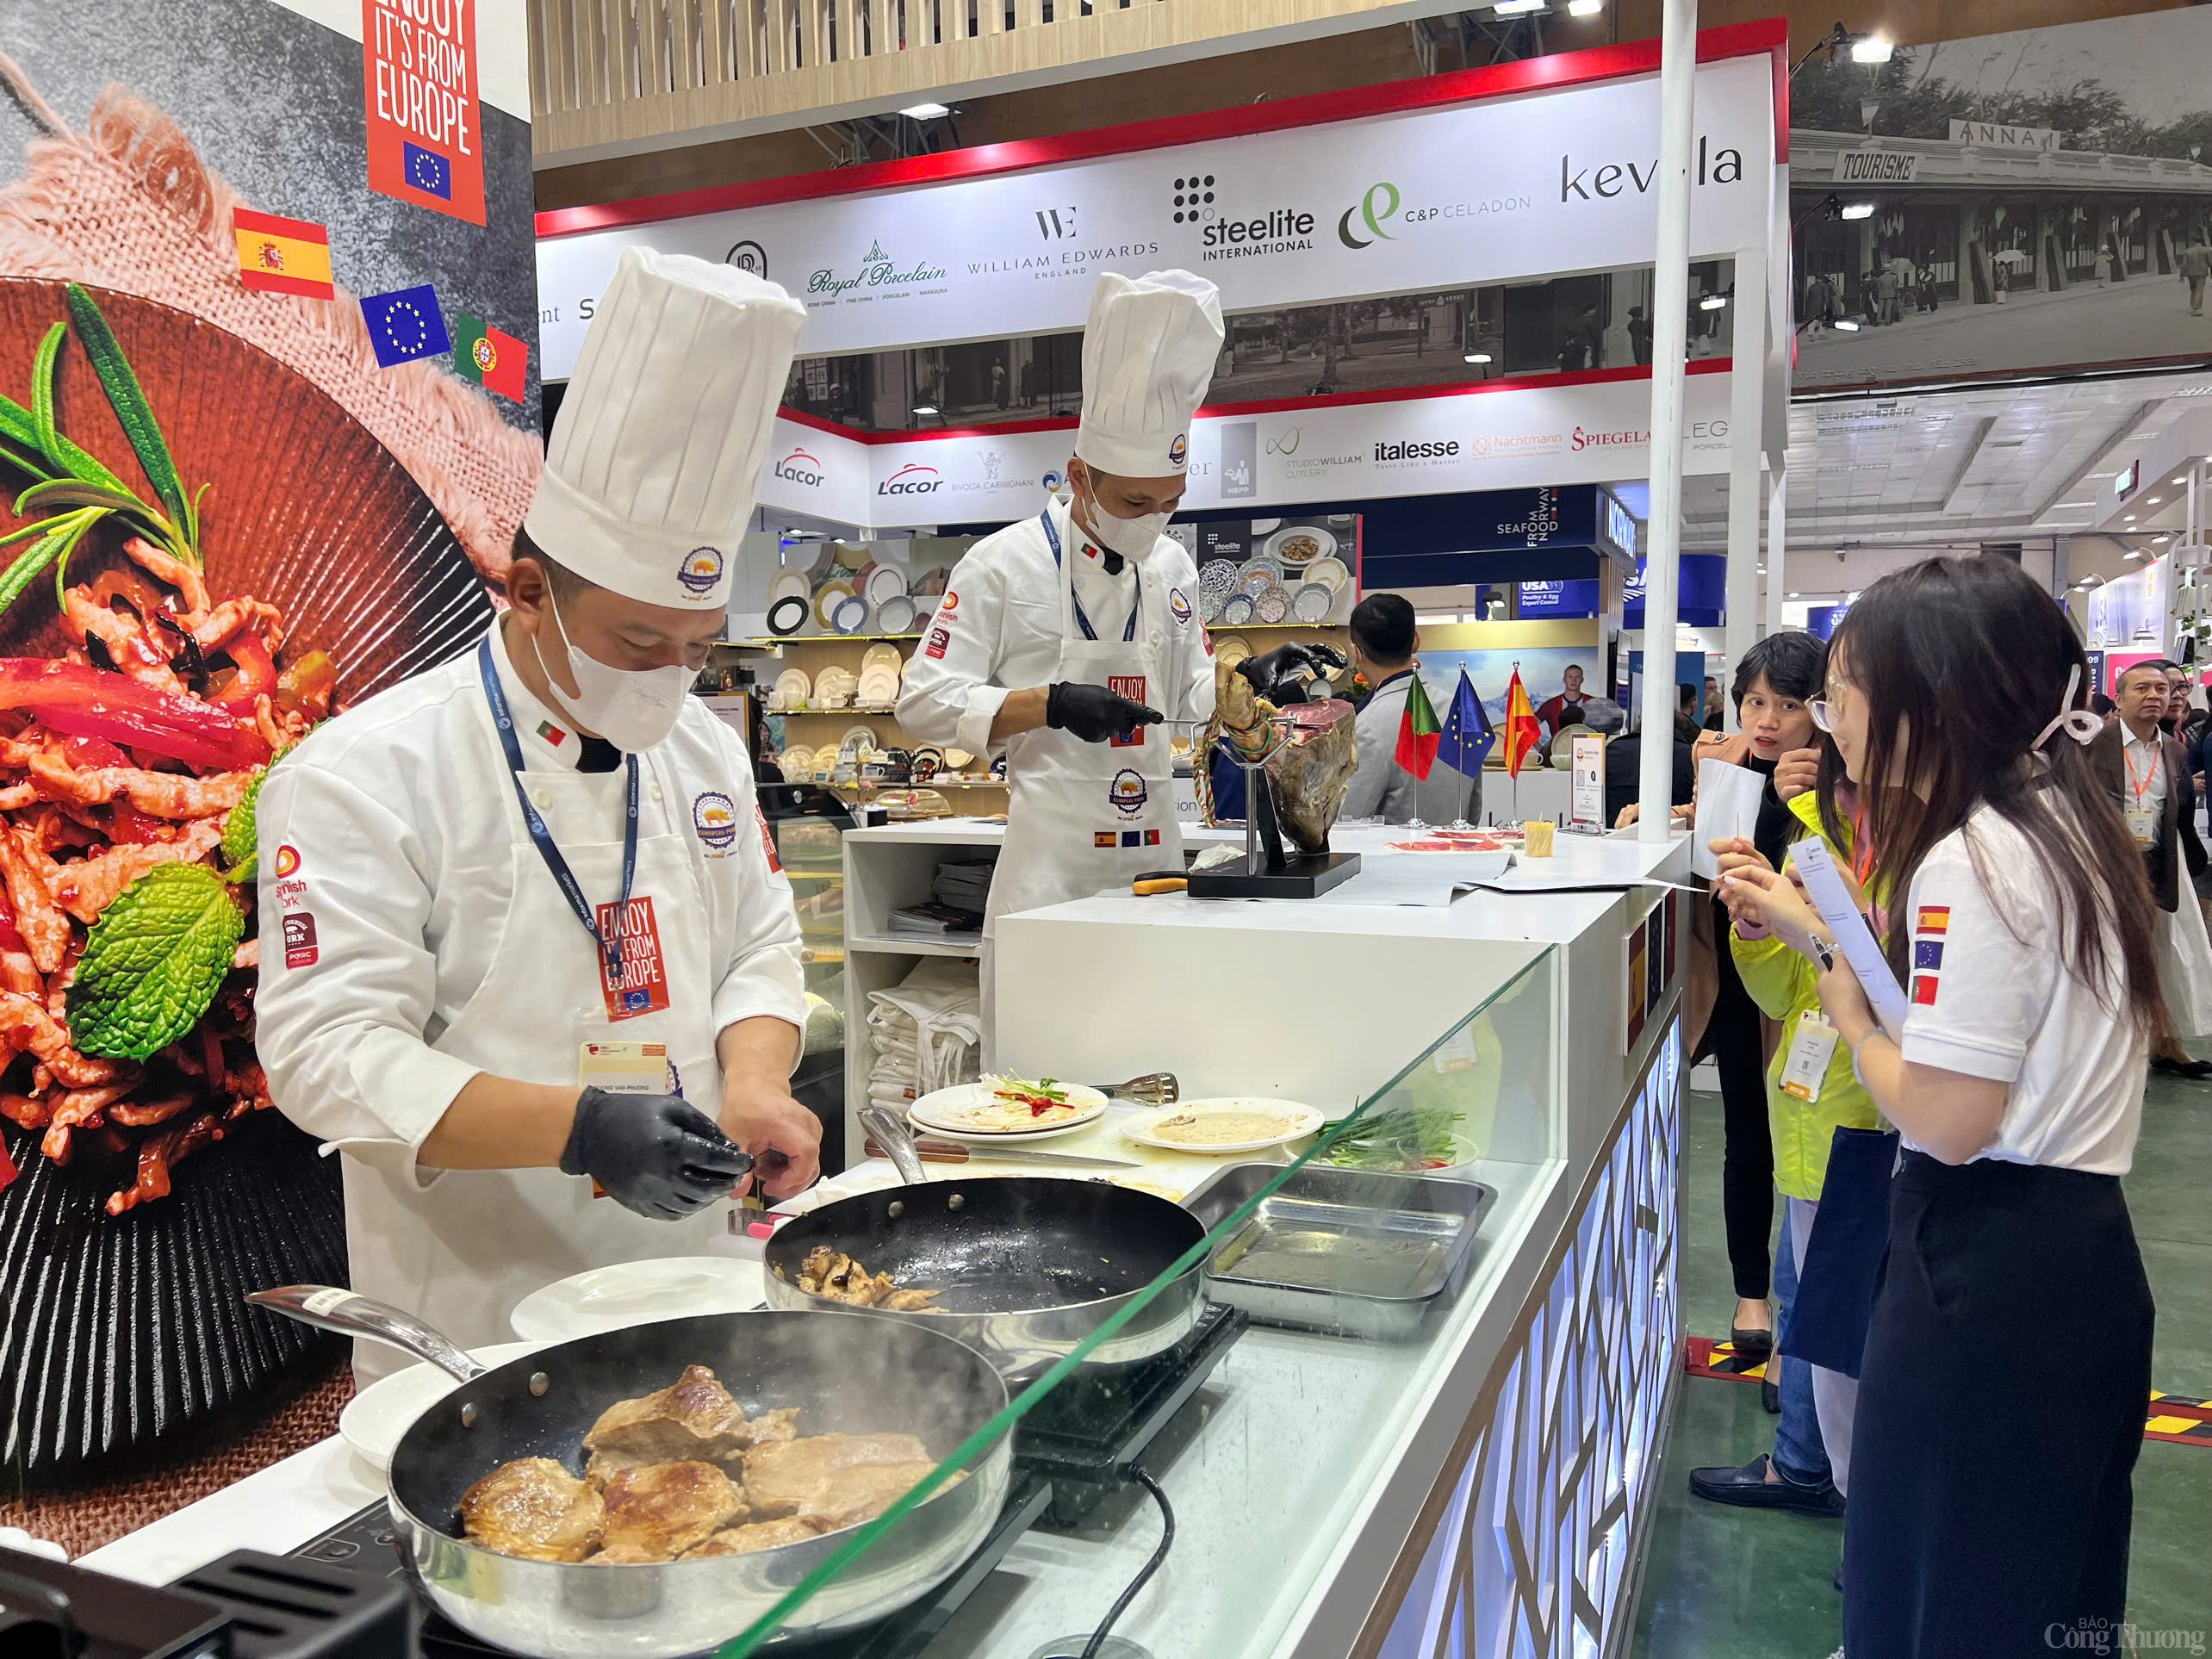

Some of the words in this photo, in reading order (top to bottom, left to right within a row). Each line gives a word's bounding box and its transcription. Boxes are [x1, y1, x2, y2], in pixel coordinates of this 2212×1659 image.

[418, 27, 467, 96] FROM
[376, 58, 472, 157] EUROPE
[1561, 134, 1743, 203] kevla
[1843, 153, 1916, 181] TOURISME
[1405, 208, 1439, 223] C&P
[1443, 196, 1531, 219] CELADON
[1202, 208, 1314, 246] steelite
[967, 255, 1050, 274] WILLIAM
[1061, 241, 1159, 264] EDWARDS
[1203, 239, 1314, 261] INTERNATIONAL
[807, 267, 868, 297] Royal
[867, 261, 948, 287] Porcelain
[1035, 266, 1087, 280] ENGLAND
[1375, 440, 1459, 461] italesse
[1494, 434, 1563, 448] Nachtmann
[1571, 426, 1651, 451] SPIEGELA
[774, 461, 824, 488] Lacor
[1285, 468, 1327, 479] CUTLERY
[877, 481, 944, 495] Lacor
[1497, 521, 1558, 534] SEAFOOD
[1538, 487, 1550, 541] NORWAY
[1527, 511, 1538, 547] FROM
[1522, 581, 1550, 591] USA
[1111, 679, 1143, 699] ENJOY
[602, 902, 649, 941] ENJOY
[624, 935, 656, 960] FROM
[605, 957, 661, 991] EROPE
